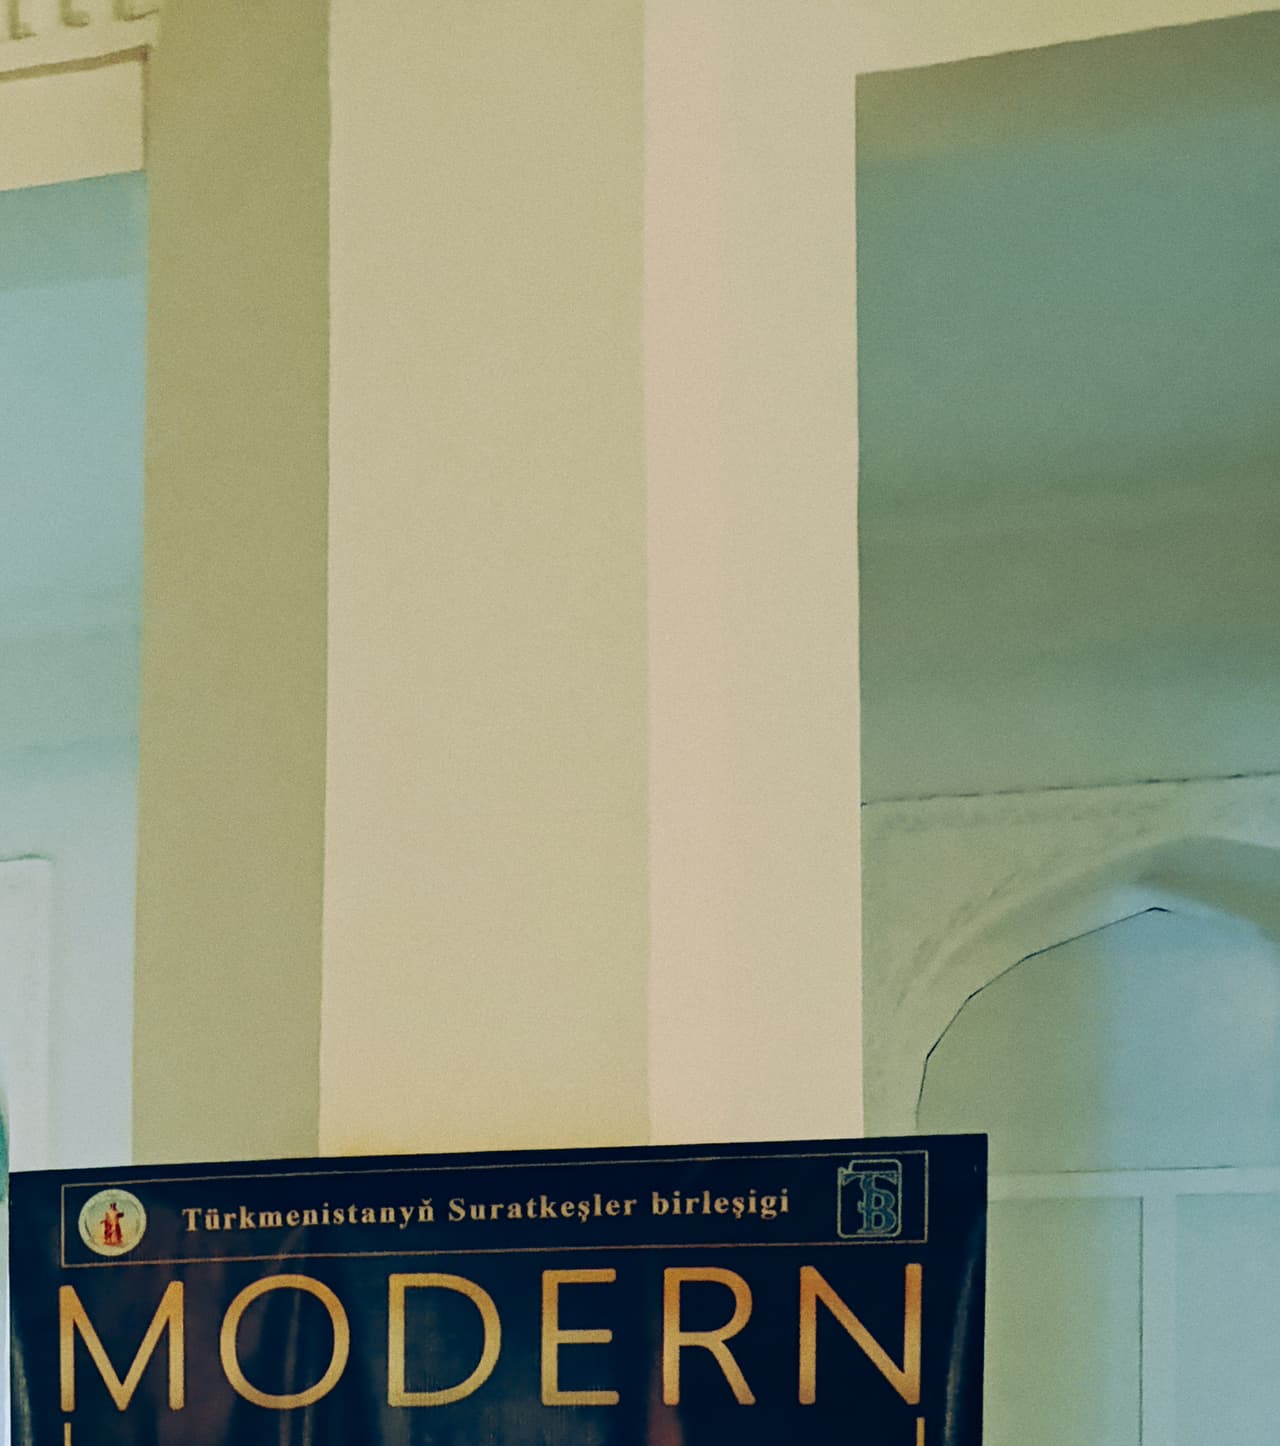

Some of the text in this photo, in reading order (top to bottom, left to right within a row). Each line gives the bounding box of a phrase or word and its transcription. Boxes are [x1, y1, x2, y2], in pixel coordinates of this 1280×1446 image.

[181, 1187, 790, 1233] Türkmenistanyň Suratkeşler birleşigi
[58, 1263, 924, 1412] MODERN
